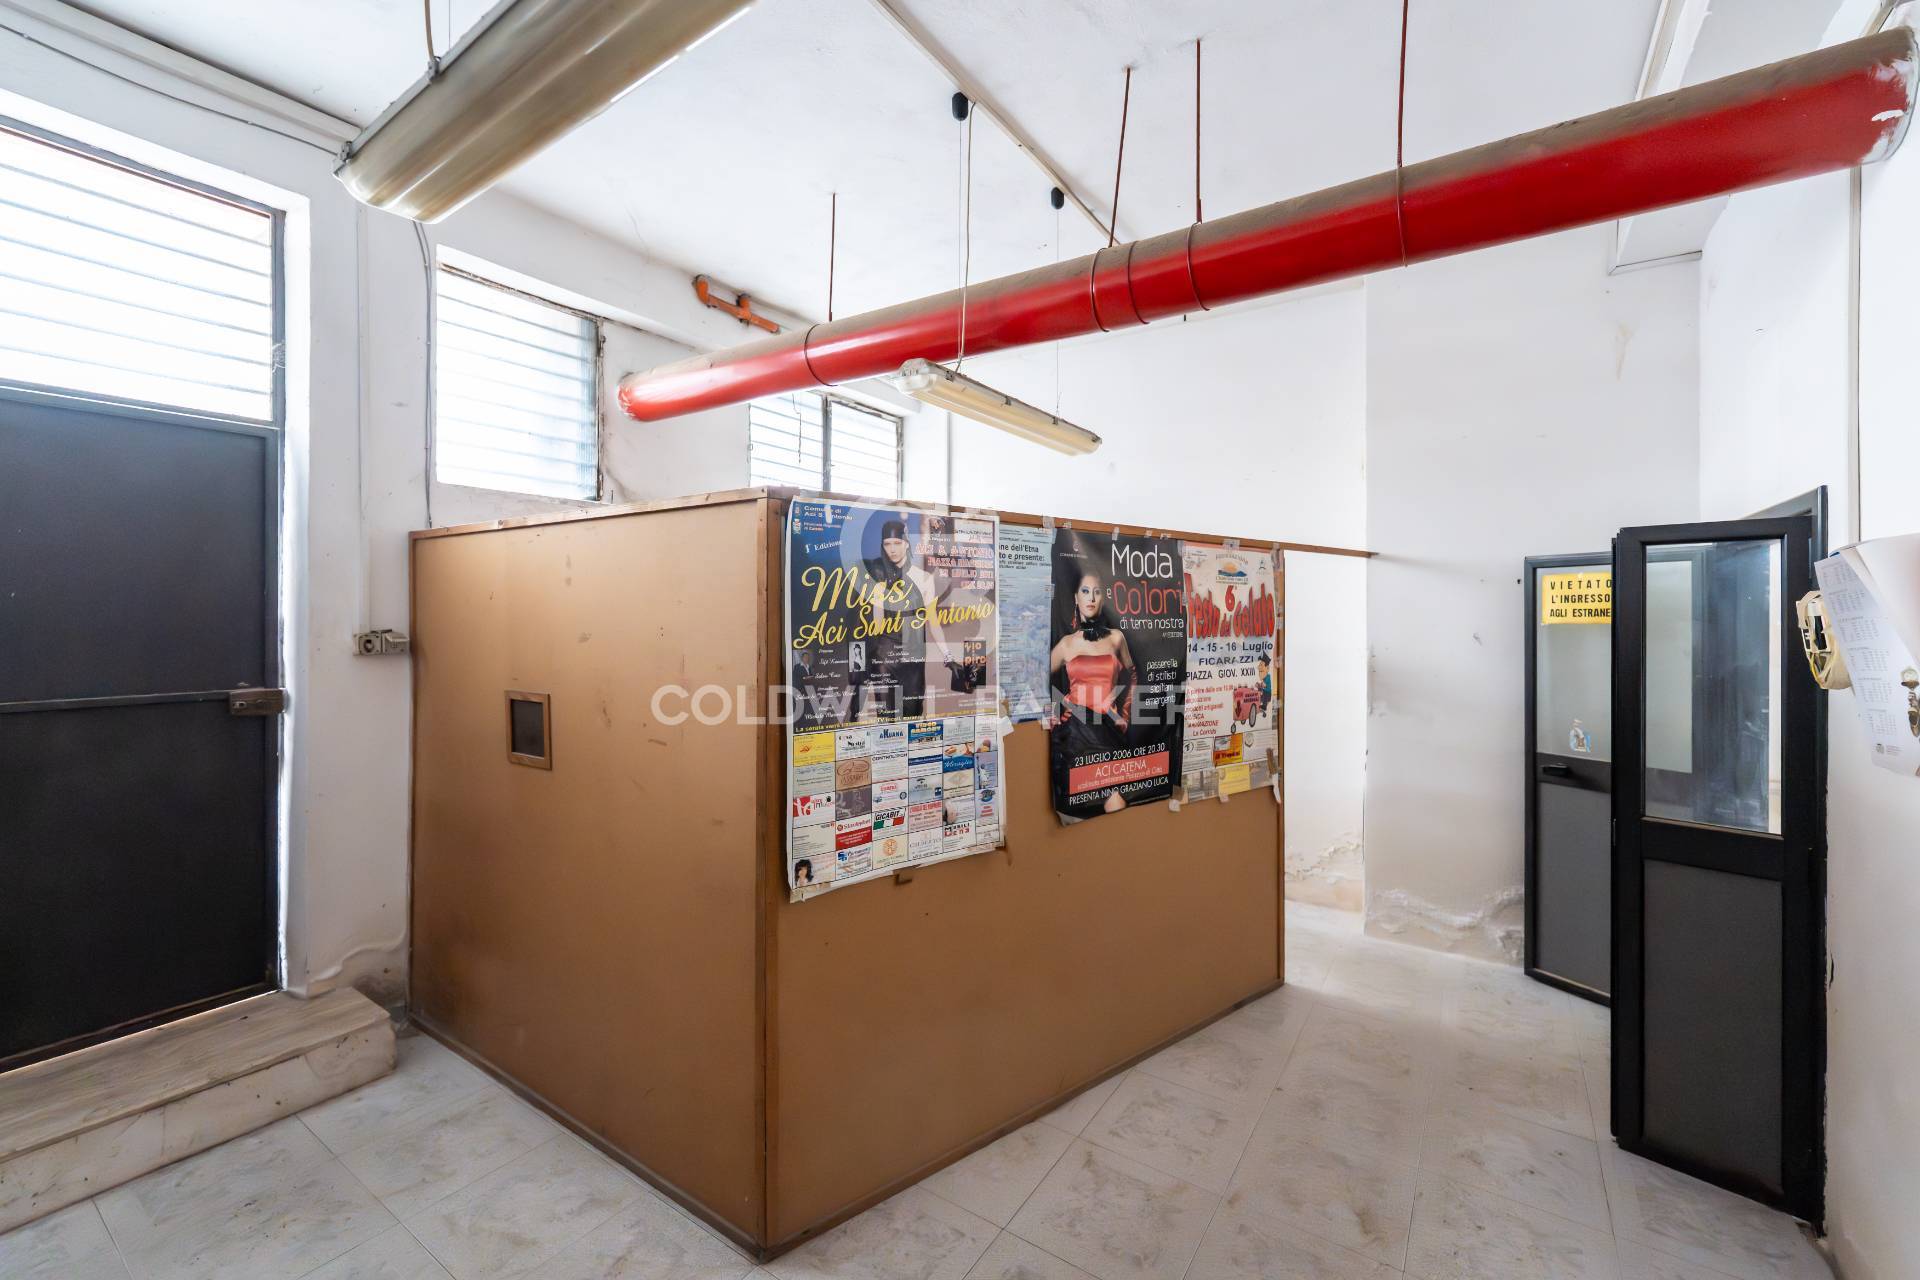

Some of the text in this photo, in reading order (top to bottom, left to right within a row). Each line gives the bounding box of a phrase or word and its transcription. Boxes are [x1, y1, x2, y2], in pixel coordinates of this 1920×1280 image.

[1010, 543, 1039, 552] dell'Etna
[1111, 543, 1173, 578] Moda
[801, 566, 913, 612] Miss
[1550, 579, 1612, 590] VIETATO
[1106, 580, 1184, 615] e Colori
[1551, 594, 1611, 604] L'INGRESSO
[1550, 608, 1612, 618] AGLI ESTRANE
[1120, 617, 1184, 630] di terra nostra
[793, 612, 847, 650] Aci
[1188, 643, 1198, 653] 14
[1207, 642, 1217, 652] 15
[1227, 642, 1237, 652] 16
[1242, 641, 1273, 653] Luglio
[1147, 658, 1178, 671] passerella
[1147, 670, 1177, 681] di stilisti
[1186, 670, 1212, 680] PIAZZA
[1218, 669, 1238, 679] GIOV.
[1145, 695, 1176, 707] emergenti
[1075, 742, 1165, 767] 23 LUGLIO 2006 ORE 20.30
[1095, 760, 1147, 777] ACI CATENA
[1069, 777, 1169, 806] PRESENTA NIN GRAZIANO LUCA
